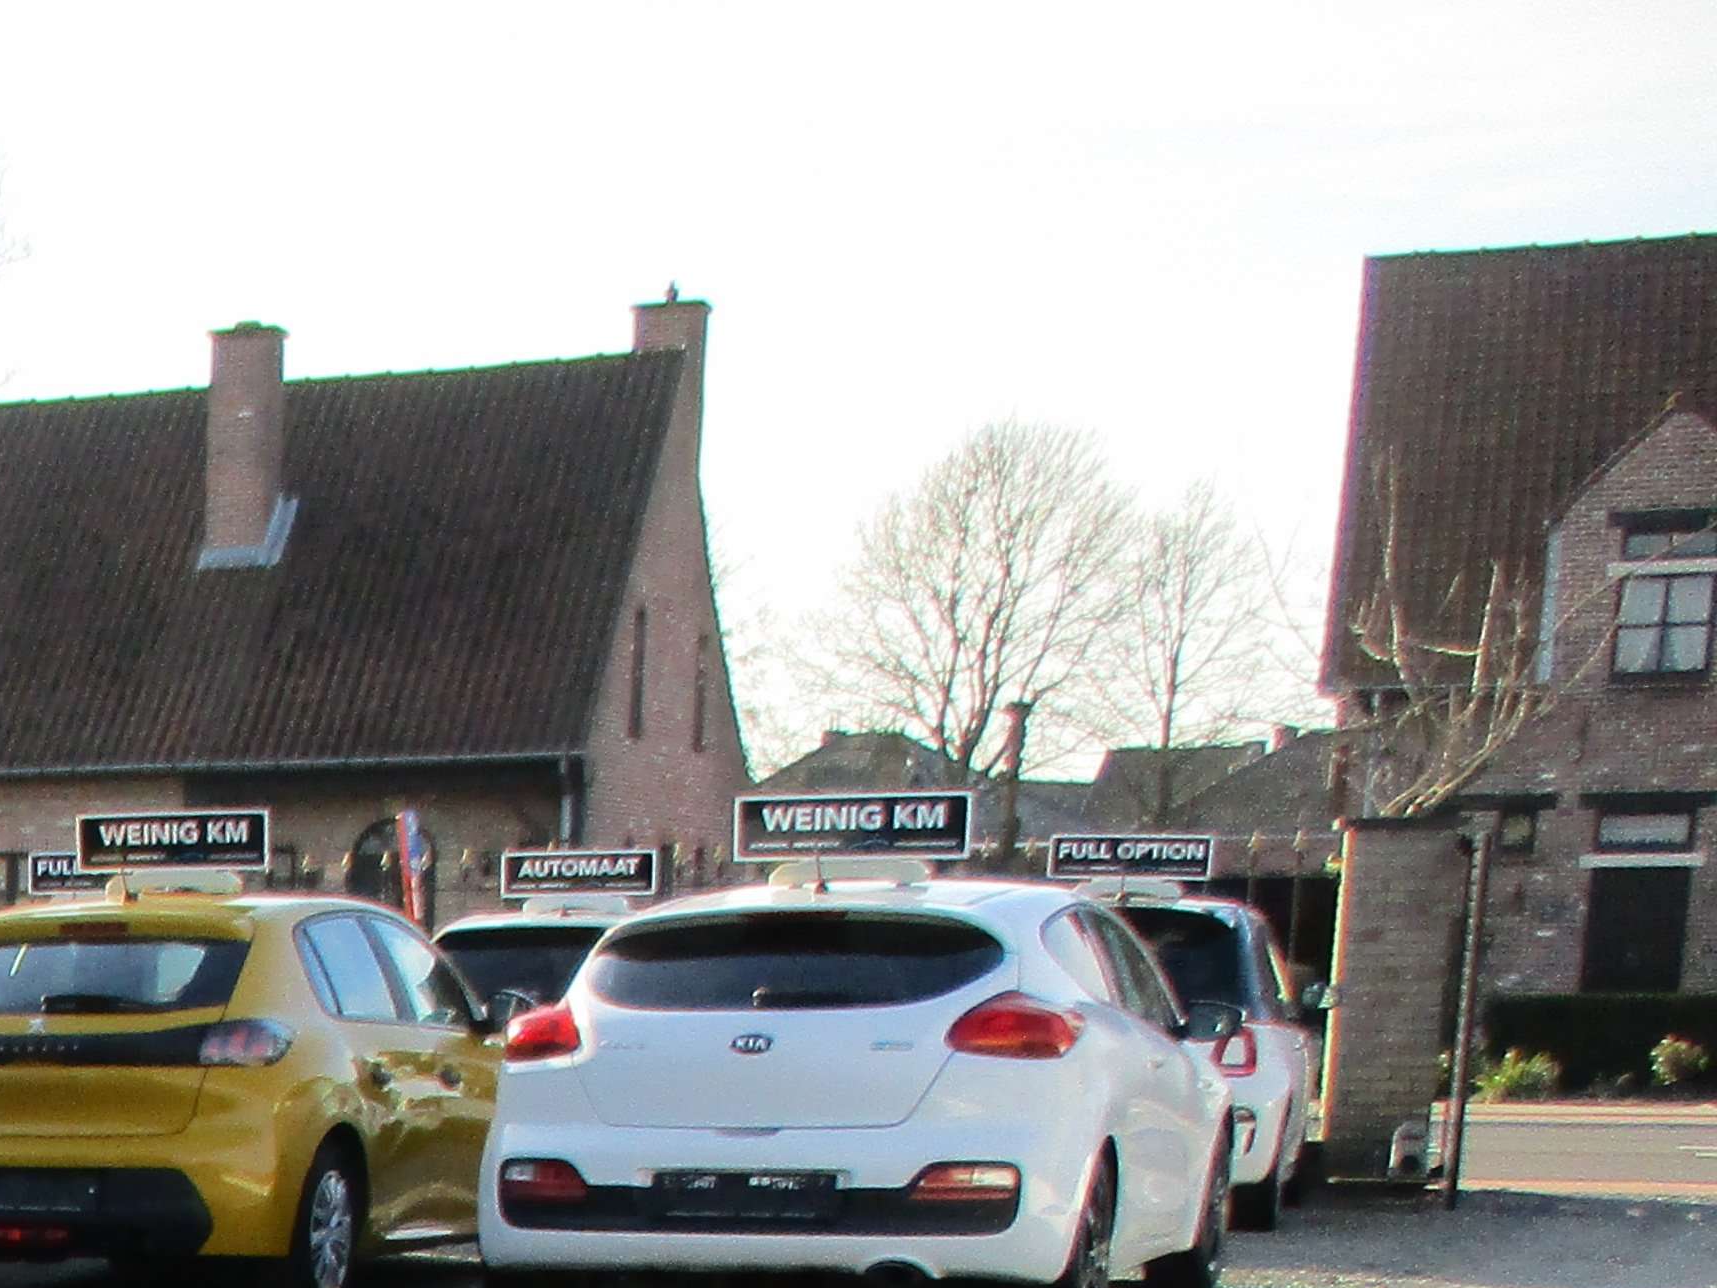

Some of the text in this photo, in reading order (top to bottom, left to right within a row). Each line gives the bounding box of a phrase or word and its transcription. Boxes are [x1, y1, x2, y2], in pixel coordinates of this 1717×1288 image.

[760, 802, 947, 833] WEINIG KM
[99, 819, 250, 847] WEINIG KM
[1057, 842, 1205, 861] FULL OPTION
[517, 857, 640, 879] AUTOMAAT
